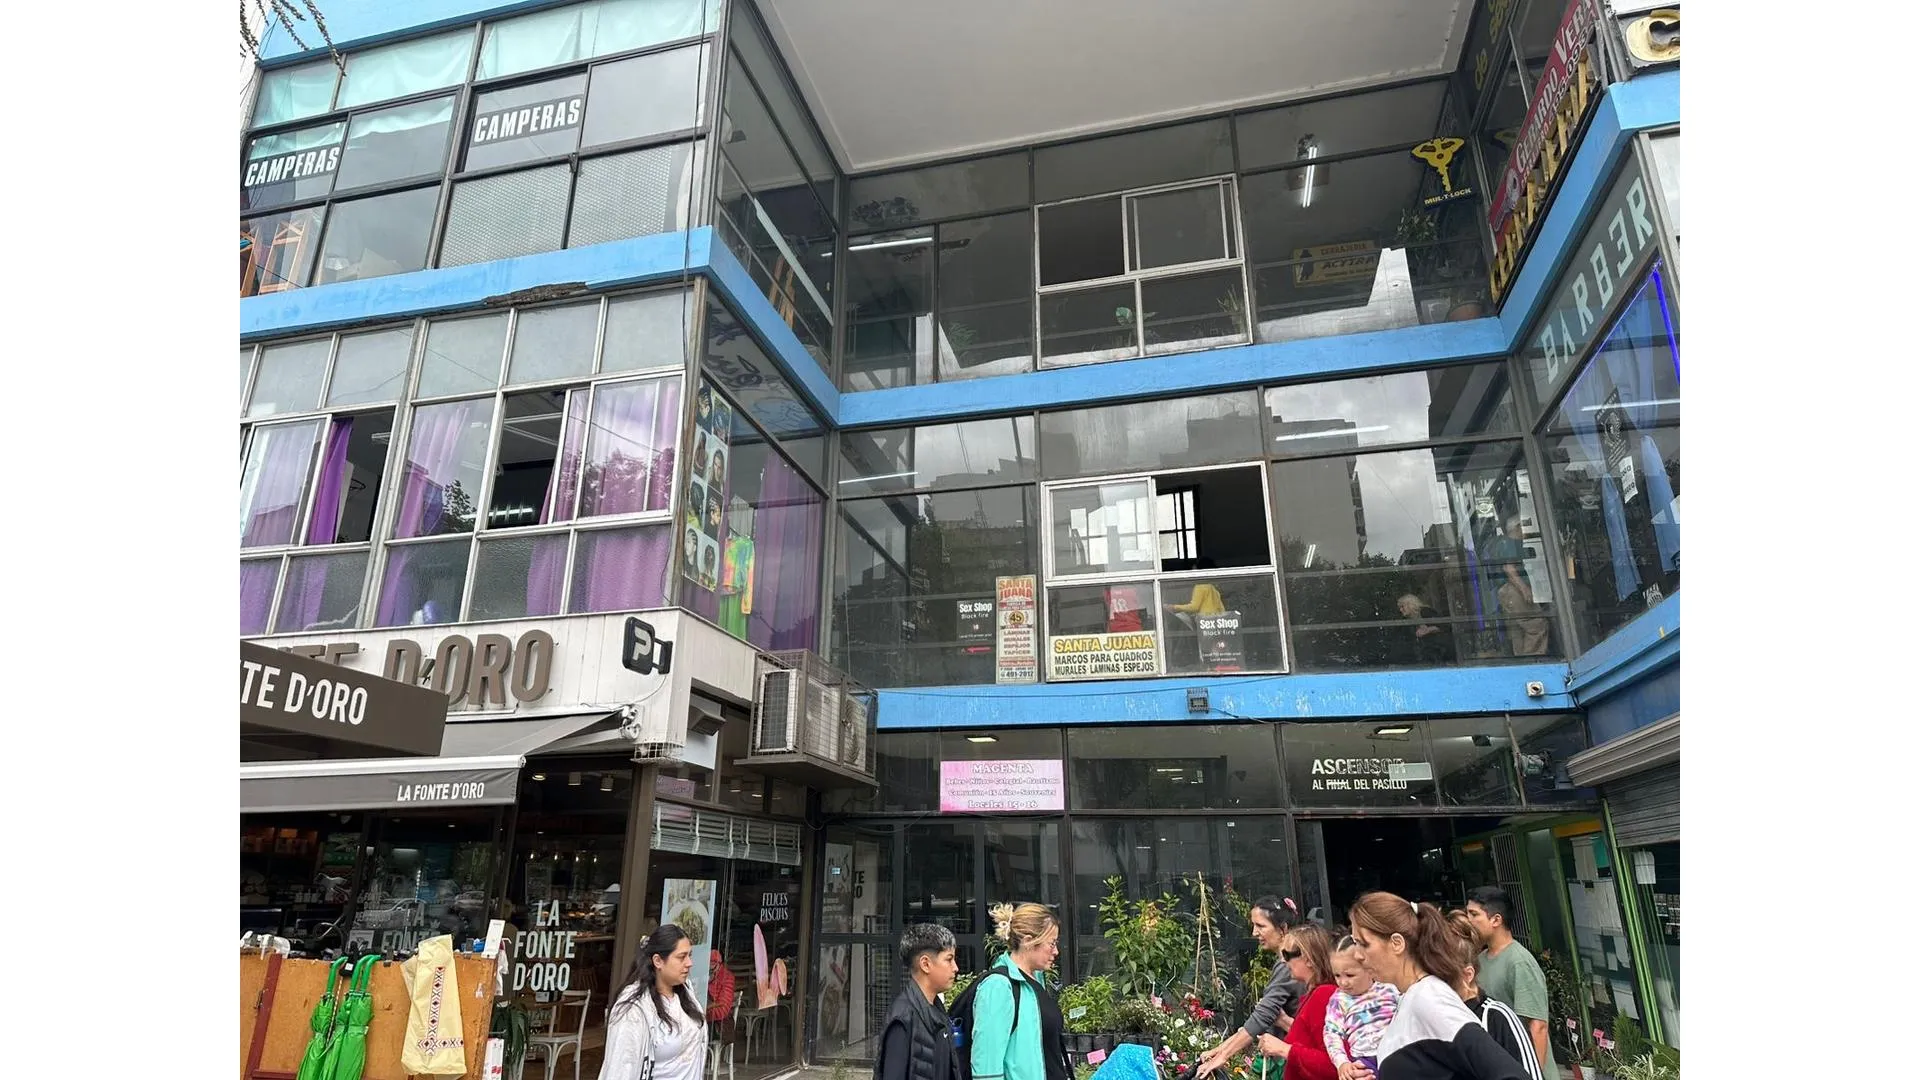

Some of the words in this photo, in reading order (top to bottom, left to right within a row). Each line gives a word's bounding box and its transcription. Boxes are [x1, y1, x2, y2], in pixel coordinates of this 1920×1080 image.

[474, 99, 581, 143] CAMPERAS
[244, 147, 340, 187] CAMPERAS
[1424, 188, 1472, 205] MUL-T-LOCK
[999, 579, 1033, 590] SANTA
[999, 588, 1033, 600] JUANA
[960, 604, 972, 613] Sex
[974, 602, 992, 612] Shop
[1010, 612, 1022, 622] 45
[1200, 619, 1215, 629] Sex
[1217, 618, 1239, 629] Shop
[1054, 637, 1102, 653] SANTA
[1104, 634, 1155, 651] JUANA
[1055, 653, 1088, 665] MARCOS
[1090, 652, 1112, 663] PARA
[1113, 651, 1153, 662] CUADROS
[1055, 665, 1087, 676] MURALES
[1090, 663, 1120, 674] LAMINAS
[1123, 661, 1154, 672] ESPEJOS
[284, 671, 368, 725] D'ORO
[972, 763, 1034, 774] MAGENTA
[1312, 758, 1406, 775] ASCENSOR
[397, 785, 411, 801] LA
[413, 783, 450, 800] FONTE
[451, 782, 485, 800] D'ORO
[1312, 779, 1324, 790] AL
[1354, 779, 1370, 789] DEL
[1373, 779, 1407, 789] PASILLO
[968, 801, 1002, 809] Locales
[762, 892, 788, 906] FELICES
[536, 899, 560, 926] LA
[760, 907, 789, 921] PASCUAS
[513, 931, 578, 958] FONTE
[512, 962, 571, 992] D'ORO
